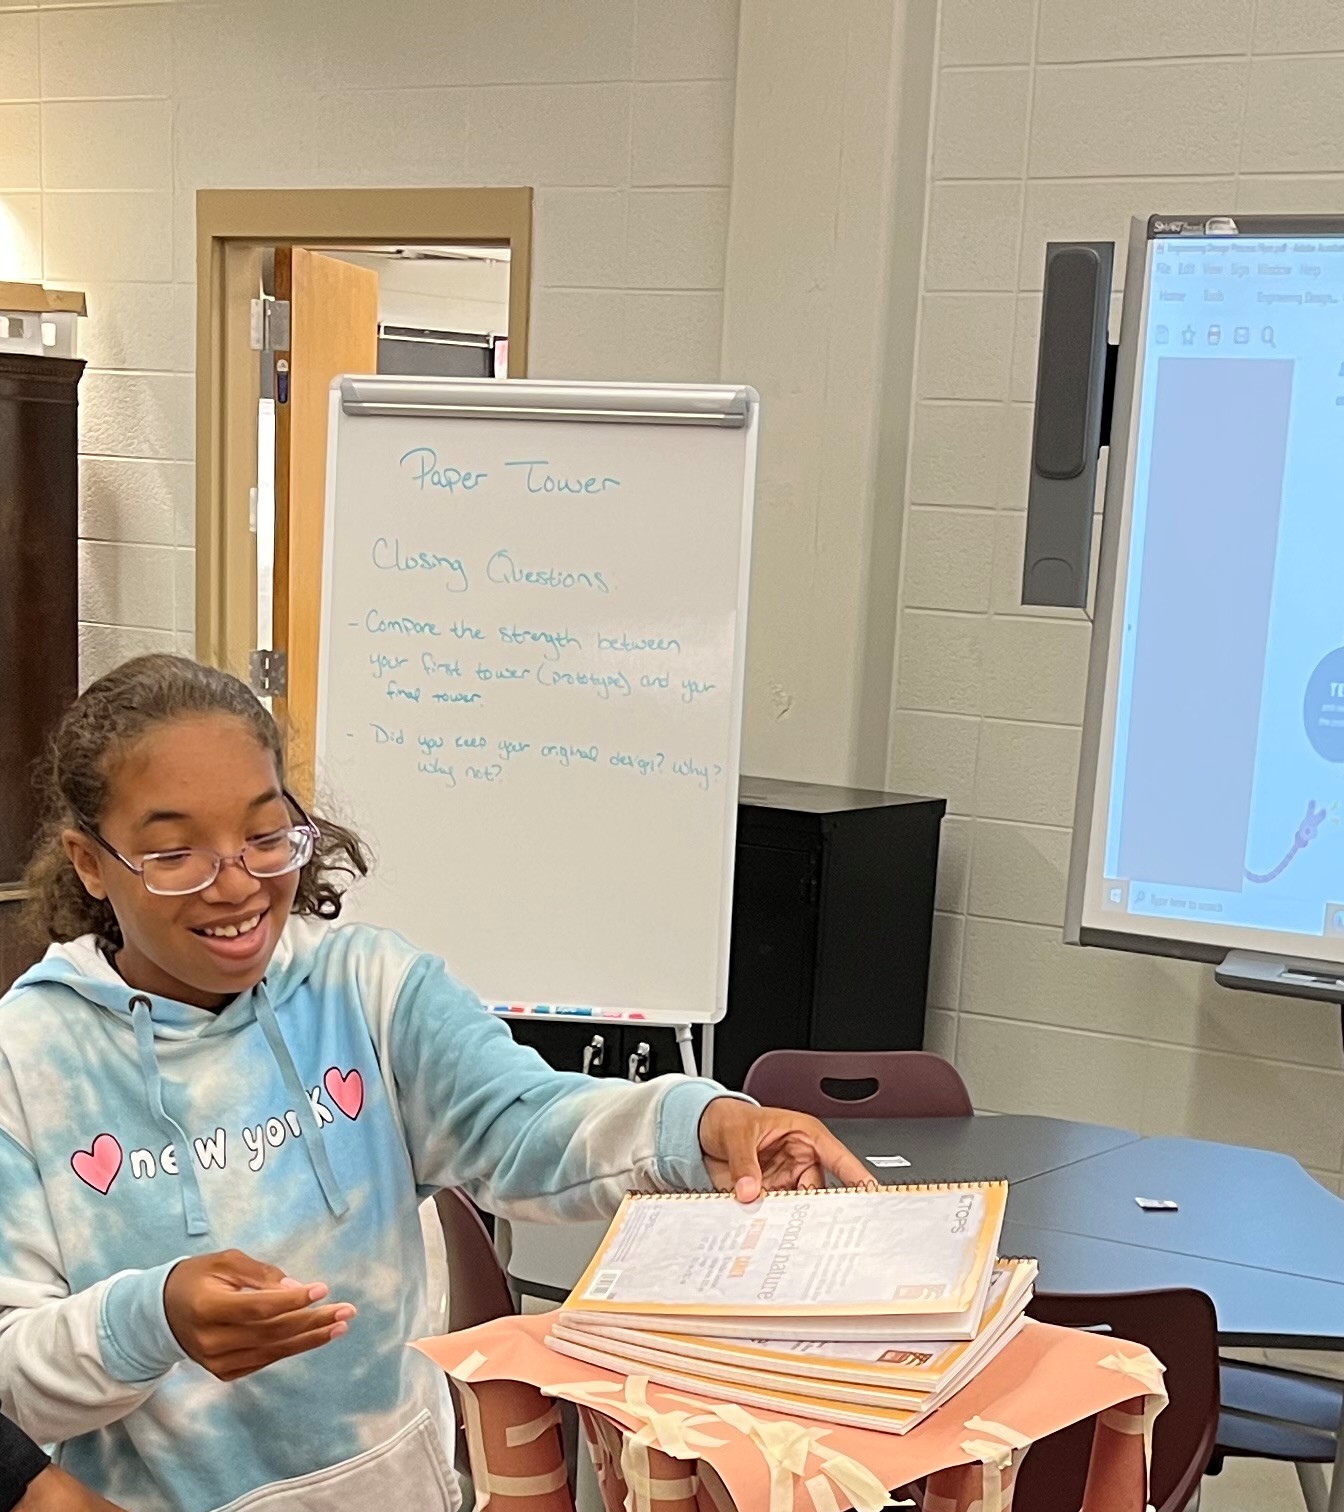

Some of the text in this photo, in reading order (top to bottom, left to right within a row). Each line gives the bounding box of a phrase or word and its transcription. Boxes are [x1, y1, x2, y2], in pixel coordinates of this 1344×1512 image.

[399, 447, 621, 494] Paper Tower
[372, 537, 469, 593] Closing
[365, 609, 681, 661] Compare the strength between
[369, 653, 408, 679] your
[421, 652, 462, 677] first
[475, 662, 531, 681] tower
[639, 671, 670, 688] and
[681, 679, 716, 704] your
[386, 680, 421, 703] final
[369, 722, 404, 745] Did
[417, 736, 444, 756] you
[497, 739, 531, 761] your
[540, 745, 599, 767] original
[130, 1085, 334, 1179] new york
[950, 1201, 973, 1235] TOPS
[757, 1203, 812, 1301] second nature
